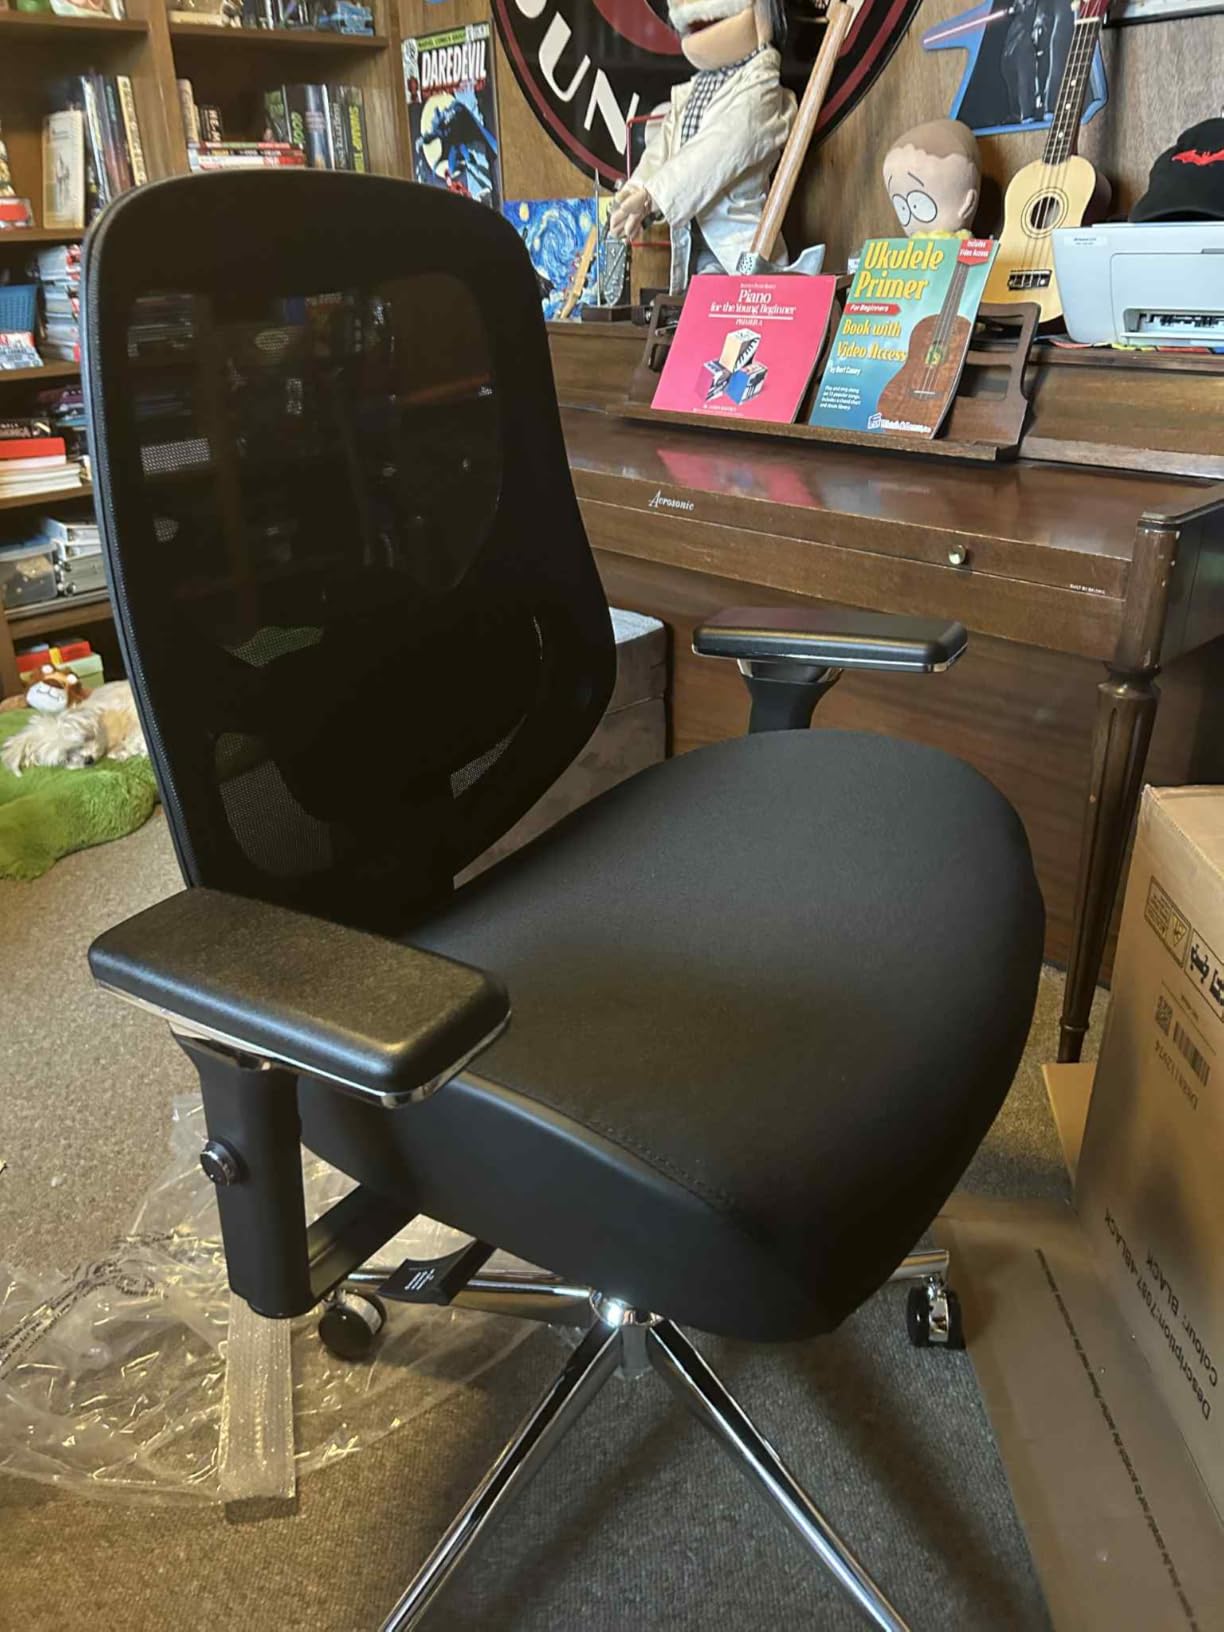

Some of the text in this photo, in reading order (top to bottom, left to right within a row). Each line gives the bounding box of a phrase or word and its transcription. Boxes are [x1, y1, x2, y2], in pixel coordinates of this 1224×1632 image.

[421, 39, 487, 90] DAREDEVIL
[864, 240, 945, 271] Ukulele
[854, 270, 929, 300] Primer
[738, 288, 772, 304] Piano
[760, 304, 796, 316] Beginner
[860, 304, 889, 313] Beginners
[842, 319, 901, 337] Book with
[837, 341, 907, 362] Video Access
[1146, 1248, 1180, 1317] BLACK
